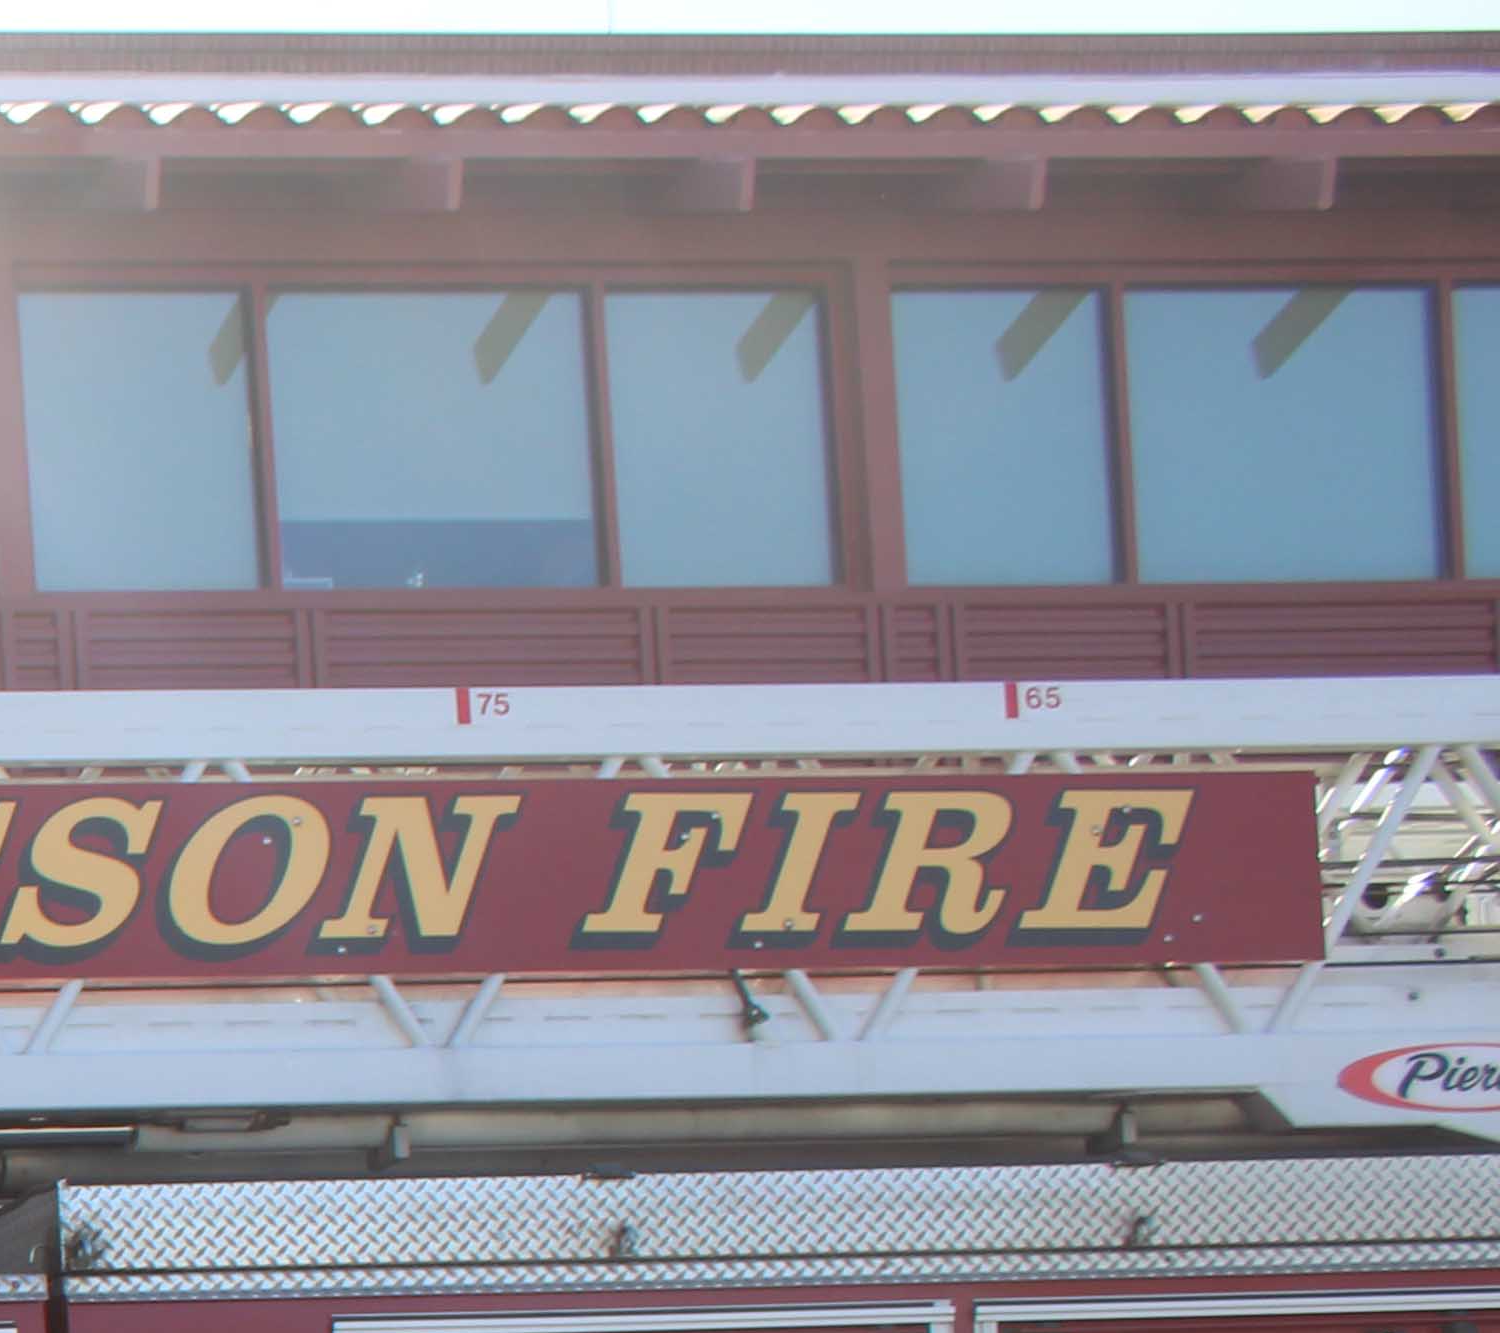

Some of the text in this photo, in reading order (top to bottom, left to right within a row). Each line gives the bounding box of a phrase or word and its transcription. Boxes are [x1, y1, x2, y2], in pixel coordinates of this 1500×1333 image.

[476, 692, 511, 717] 75
[1025, 687, 1062, 710] 65
[579, 787, 1197, 942] FIRE
[1397, 1052, 1500, 1100] Pier
